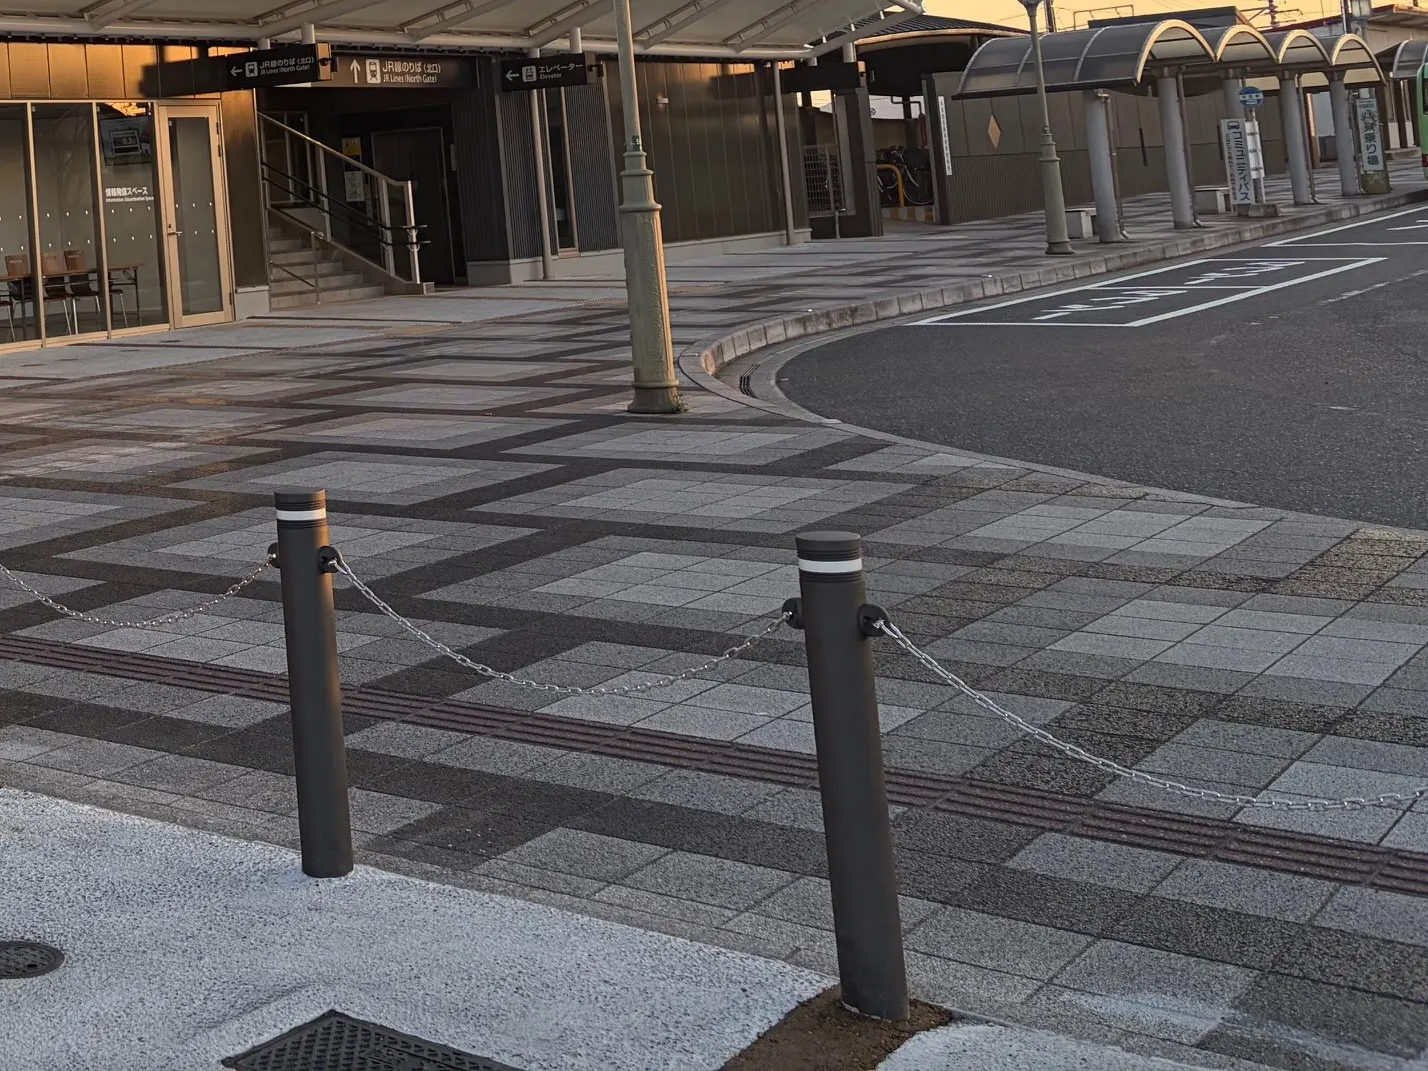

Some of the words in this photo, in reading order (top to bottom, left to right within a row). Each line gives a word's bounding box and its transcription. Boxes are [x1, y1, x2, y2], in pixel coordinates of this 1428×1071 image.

[538, 62, 584, 73] エレベーター
[383, 74, 391, 83] JR
[390, 74, 404, 83] Lines
[404, 74, 422, 83] (North
[422, 74, 438, 84] Gate)
[539, 72, 563, 80] Elevator
[1232, 131, 1251, 201] コミュニティバス
